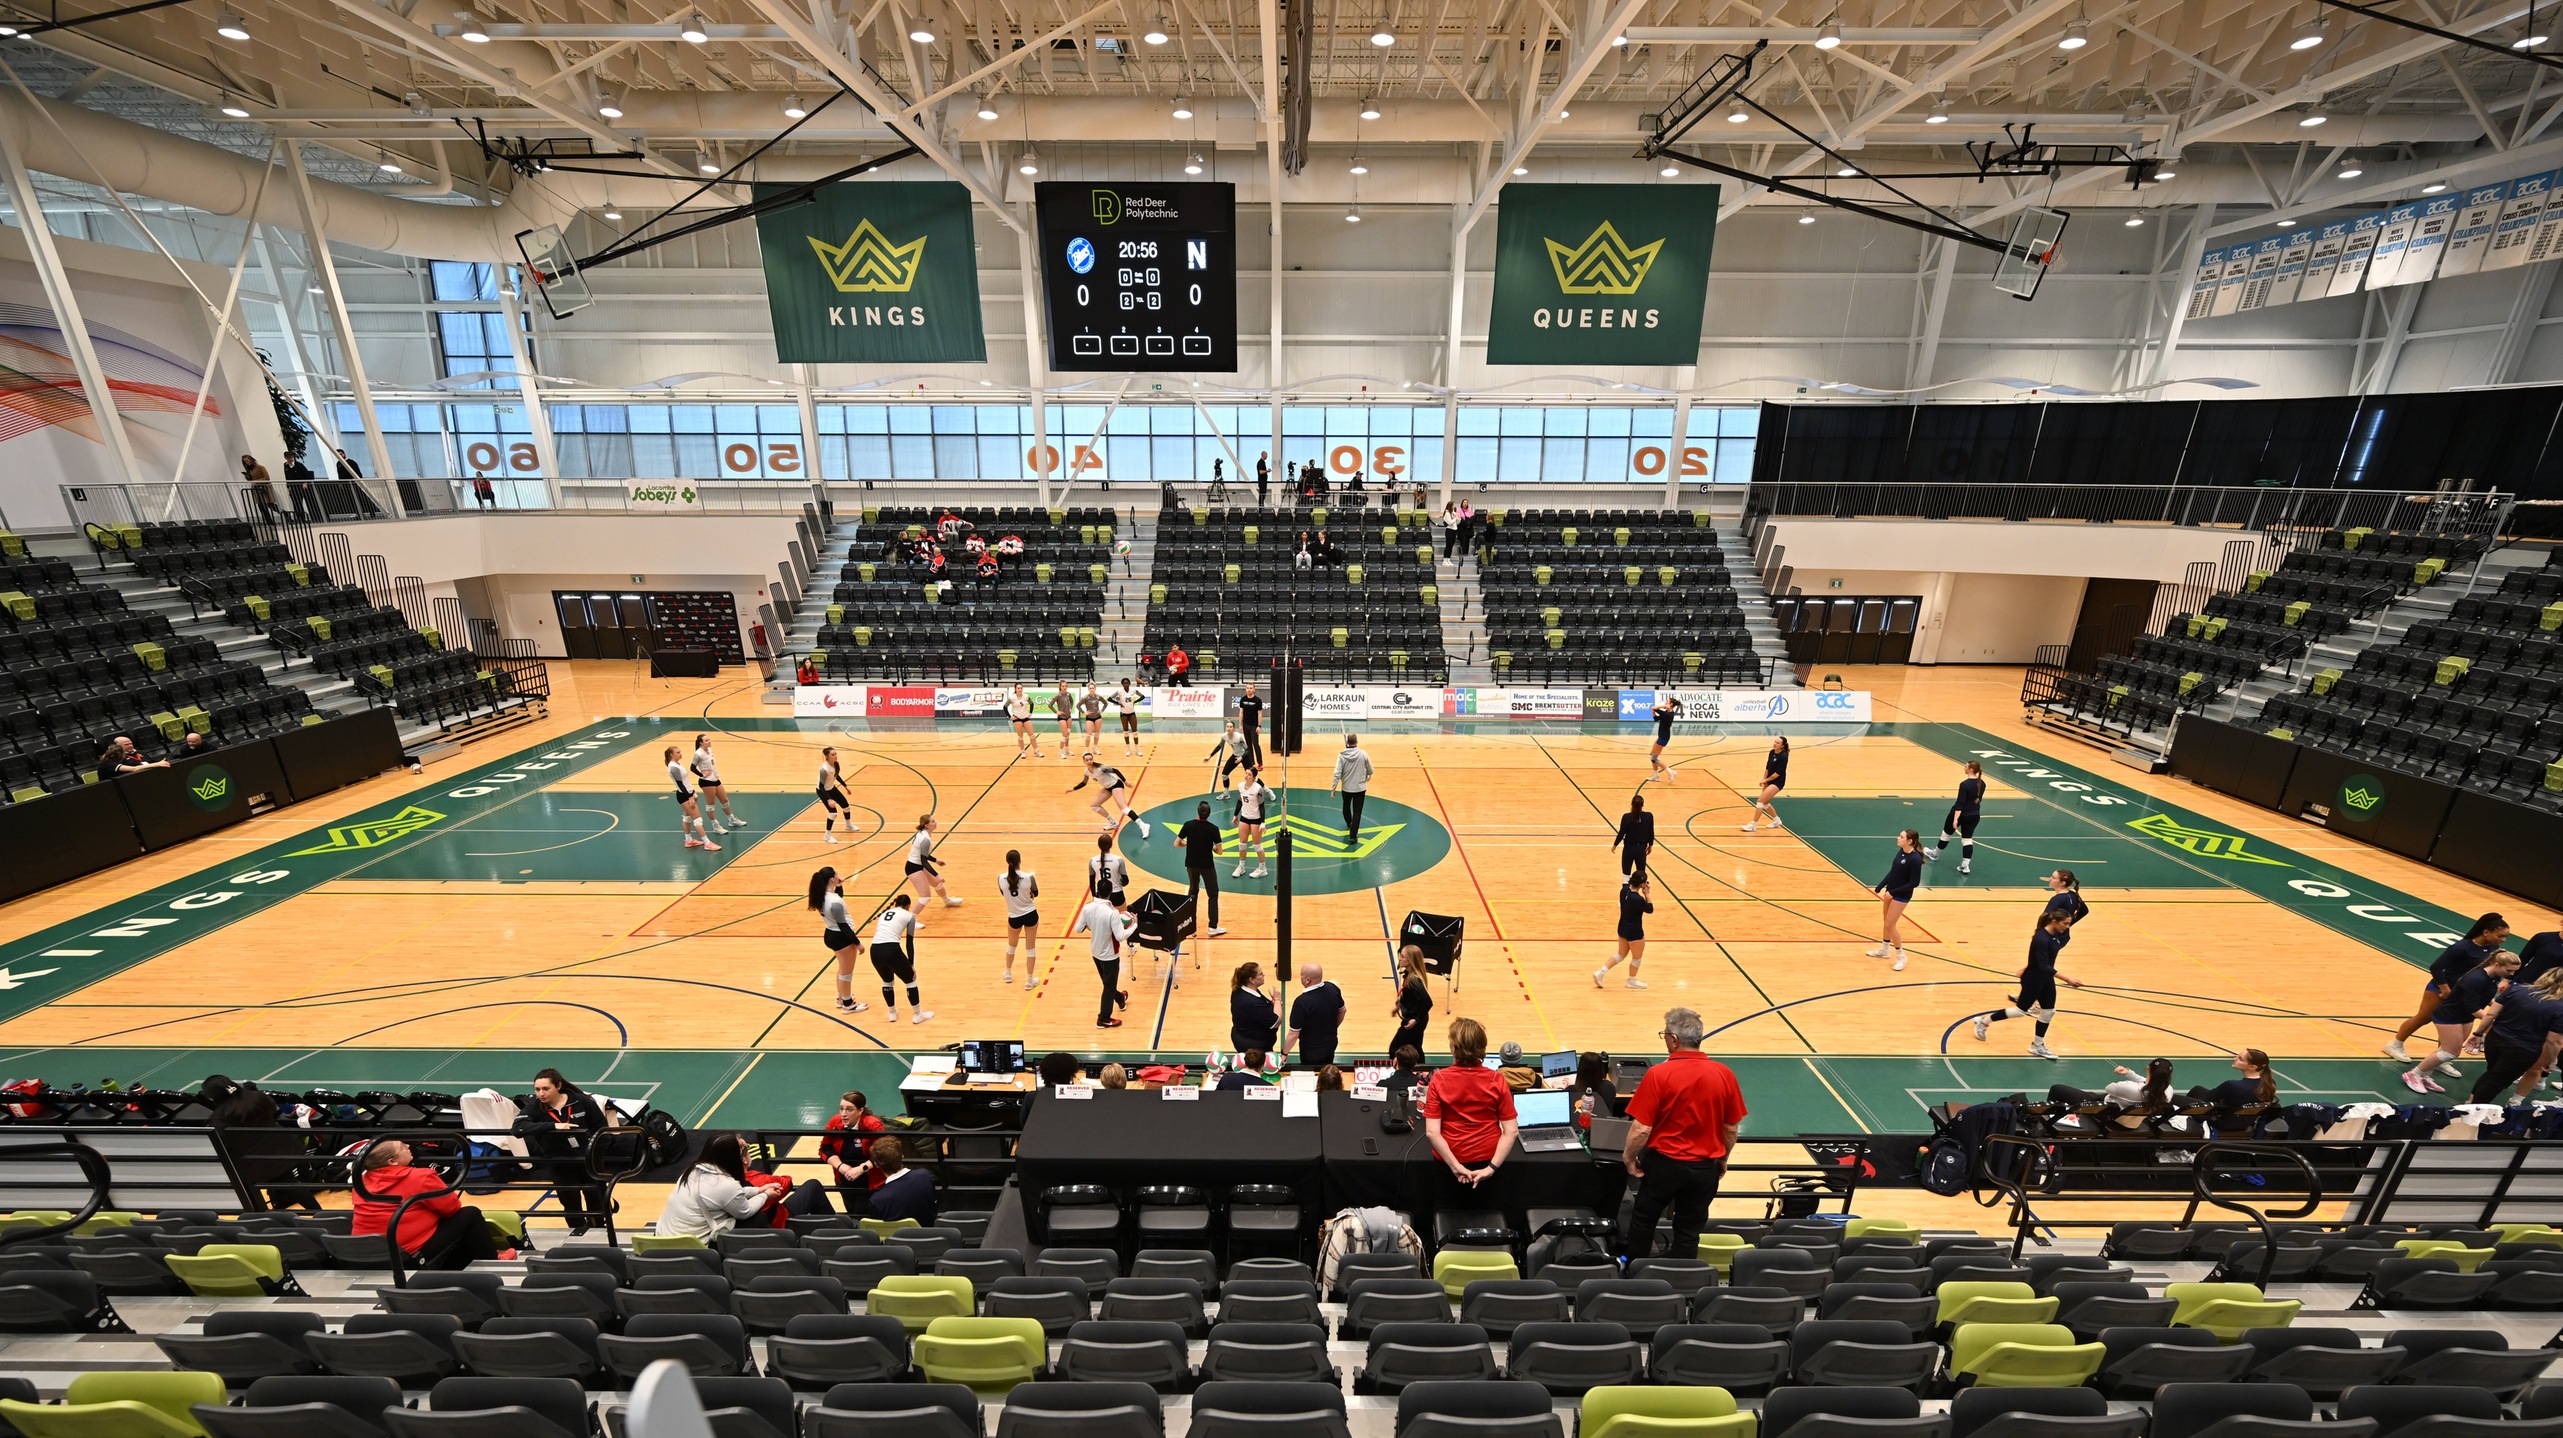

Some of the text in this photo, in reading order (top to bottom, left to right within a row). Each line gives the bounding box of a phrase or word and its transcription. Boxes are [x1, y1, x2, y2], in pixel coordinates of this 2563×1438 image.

[2517, 178, 2547, 197] acac
[1126, 198, 1166, 207] Red Deer
[2471, 187, 2501, 206] acac
[2427, 198, 2455, 215] acac
[2502, 211, 2518, 220] CROSS
[2518, 206, 2542, 217] COUNTRY
[1126, 208, 1178, 220] Polytechnic
[2391, 206, 2415, 223] acac
[2472, 210, 2487, 218] MEN'S
[2470, 218, 2484, 226] GOLF
[2498, 216, 2538, 232] CHAMPIONS
[2423, 226, 2441, 234] SOCCER
[2453, 224, 2492, 239] CHAMPIONS
[2411, 234, 2446, 248] CHAMPIONS
[1119, 242, 1157, 258] 20:56
[1187, 241, 1206, 270] N
[1123, 273, 1128, 282] 0
[1150, 273, 1156, 282] 0
[1077, 284, 1090, 306] 0
[1124, 297, 1130, 306] 2
[1151, 297, 1157, 306] 2
[1190, 284, 1202, 306] 0
[829, 307, 925, 326] KINGS
[1533, 308, 1659, 329] QUEENS
[632, 487, 677, 504] Sobeys
[1700, 485, 1708, 493] G
[2489, 499, 2498, 509] F
[921, 542, 928, 551] N
[891, 698, 934, 706] BODYARMOR
[1168, 689, 1216, 702] Prairie
[1320, 694, 1365, 702] LARKAUN
[1444, 693, 1476, 702] mac.
[1586, 697, 1614, 707] kraze
[1660, 693, 1722, 701] THE ADVOCATE
[1815, 693, 1855, 709] acac
[1511, 703, 1532, 711] SMC
[1621, 699, 1635, 714] X
[1734, 704, 1766, 712] alberta
[448, 730, 631, 798] QUEENS
[1970, 750, 2128, 807] KINGS
[884, 911, 895, 921] 8
[0, 869, 290, 988] KINGS
